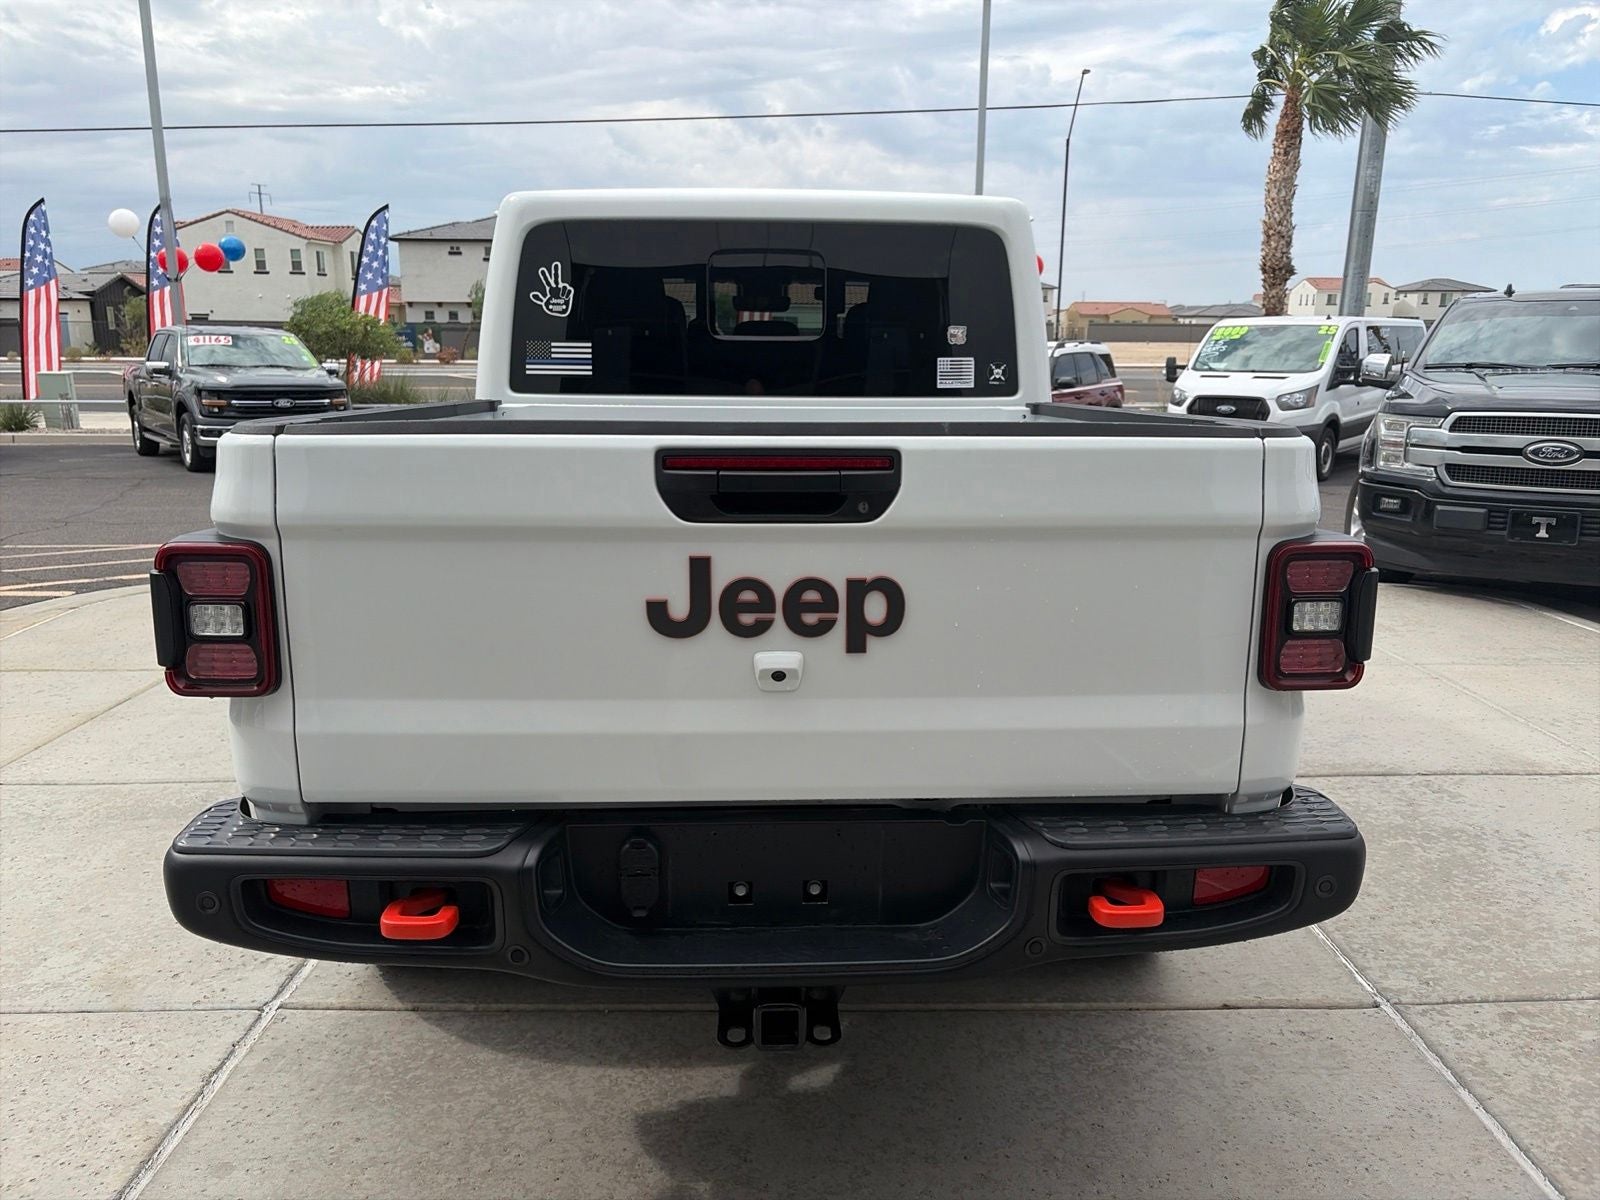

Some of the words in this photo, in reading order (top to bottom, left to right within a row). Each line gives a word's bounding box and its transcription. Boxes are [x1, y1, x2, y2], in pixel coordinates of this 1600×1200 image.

[1539, 446, 1568, 458] Ford
[1532, 516, 1557, 538] T
[646, 555, 906, 654] Jeep
